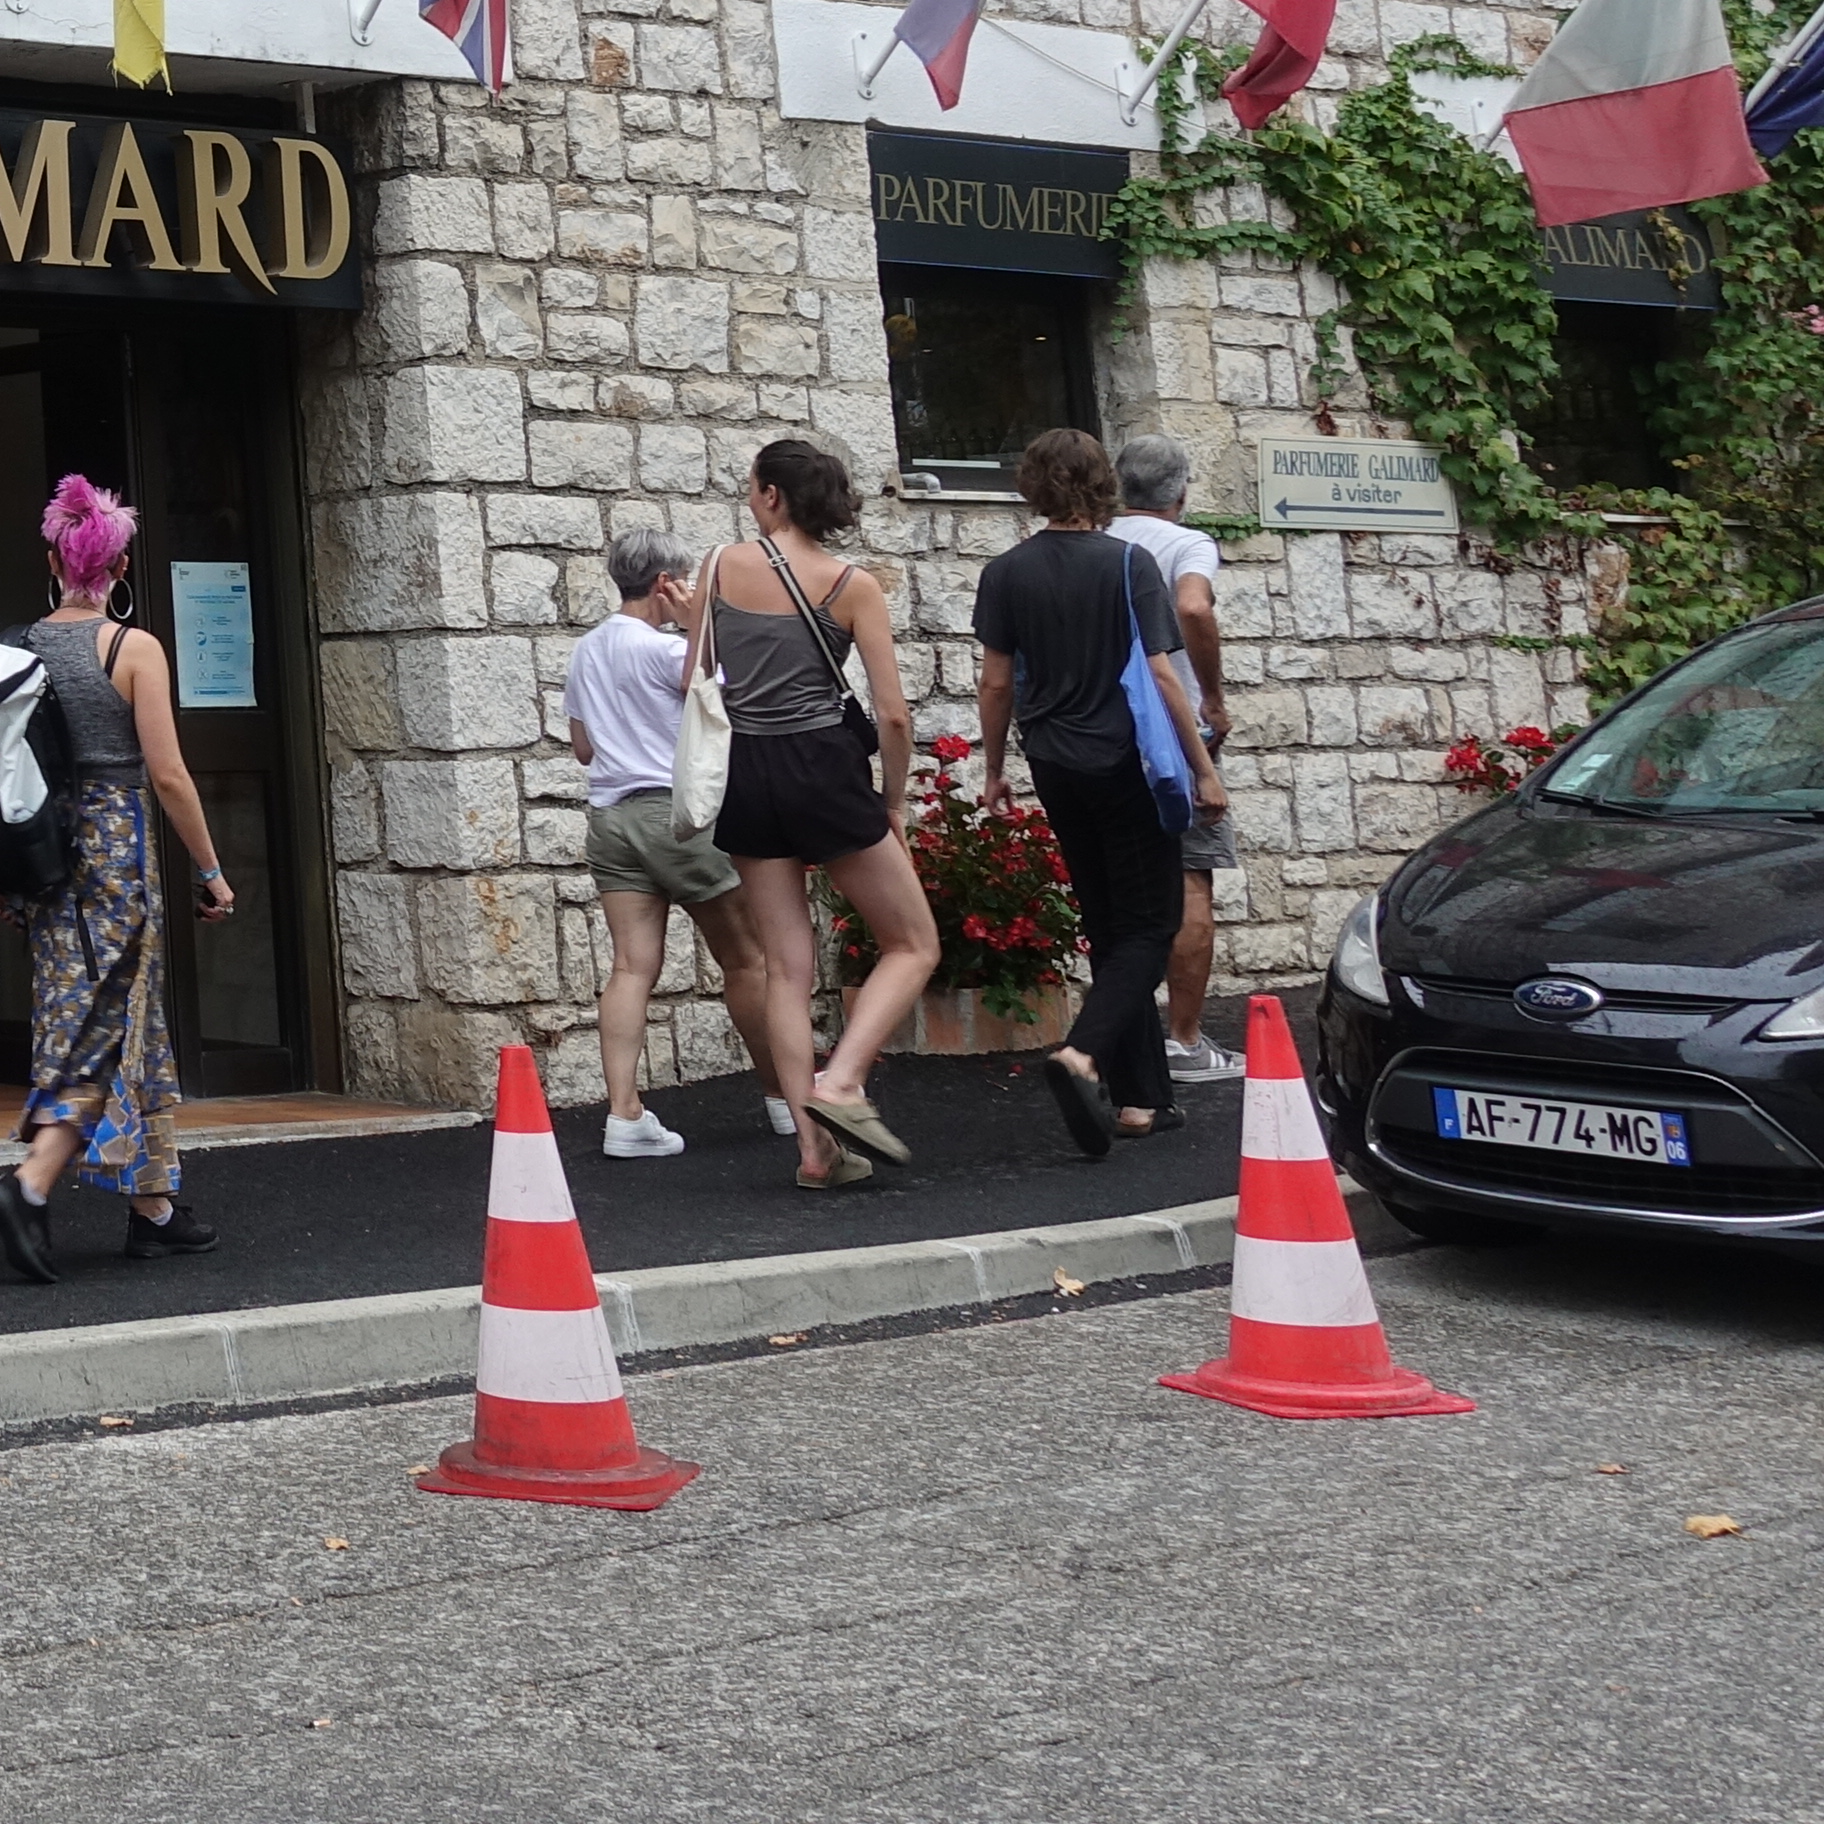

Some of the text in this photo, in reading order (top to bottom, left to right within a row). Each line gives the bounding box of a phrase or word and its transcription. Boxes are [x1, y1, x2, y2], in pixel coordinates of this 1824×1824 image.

[1544, 224, 1706, 274] ALIMAD
[1273, 450, 1440, 483] PARFUMERIE GALIMARD
[1331, 483, 1402, 504] à visiter
[1530, 983, 1576, 1007] Ford
[1444, 1096, 1687, 1160] F AF-774-MG 06
